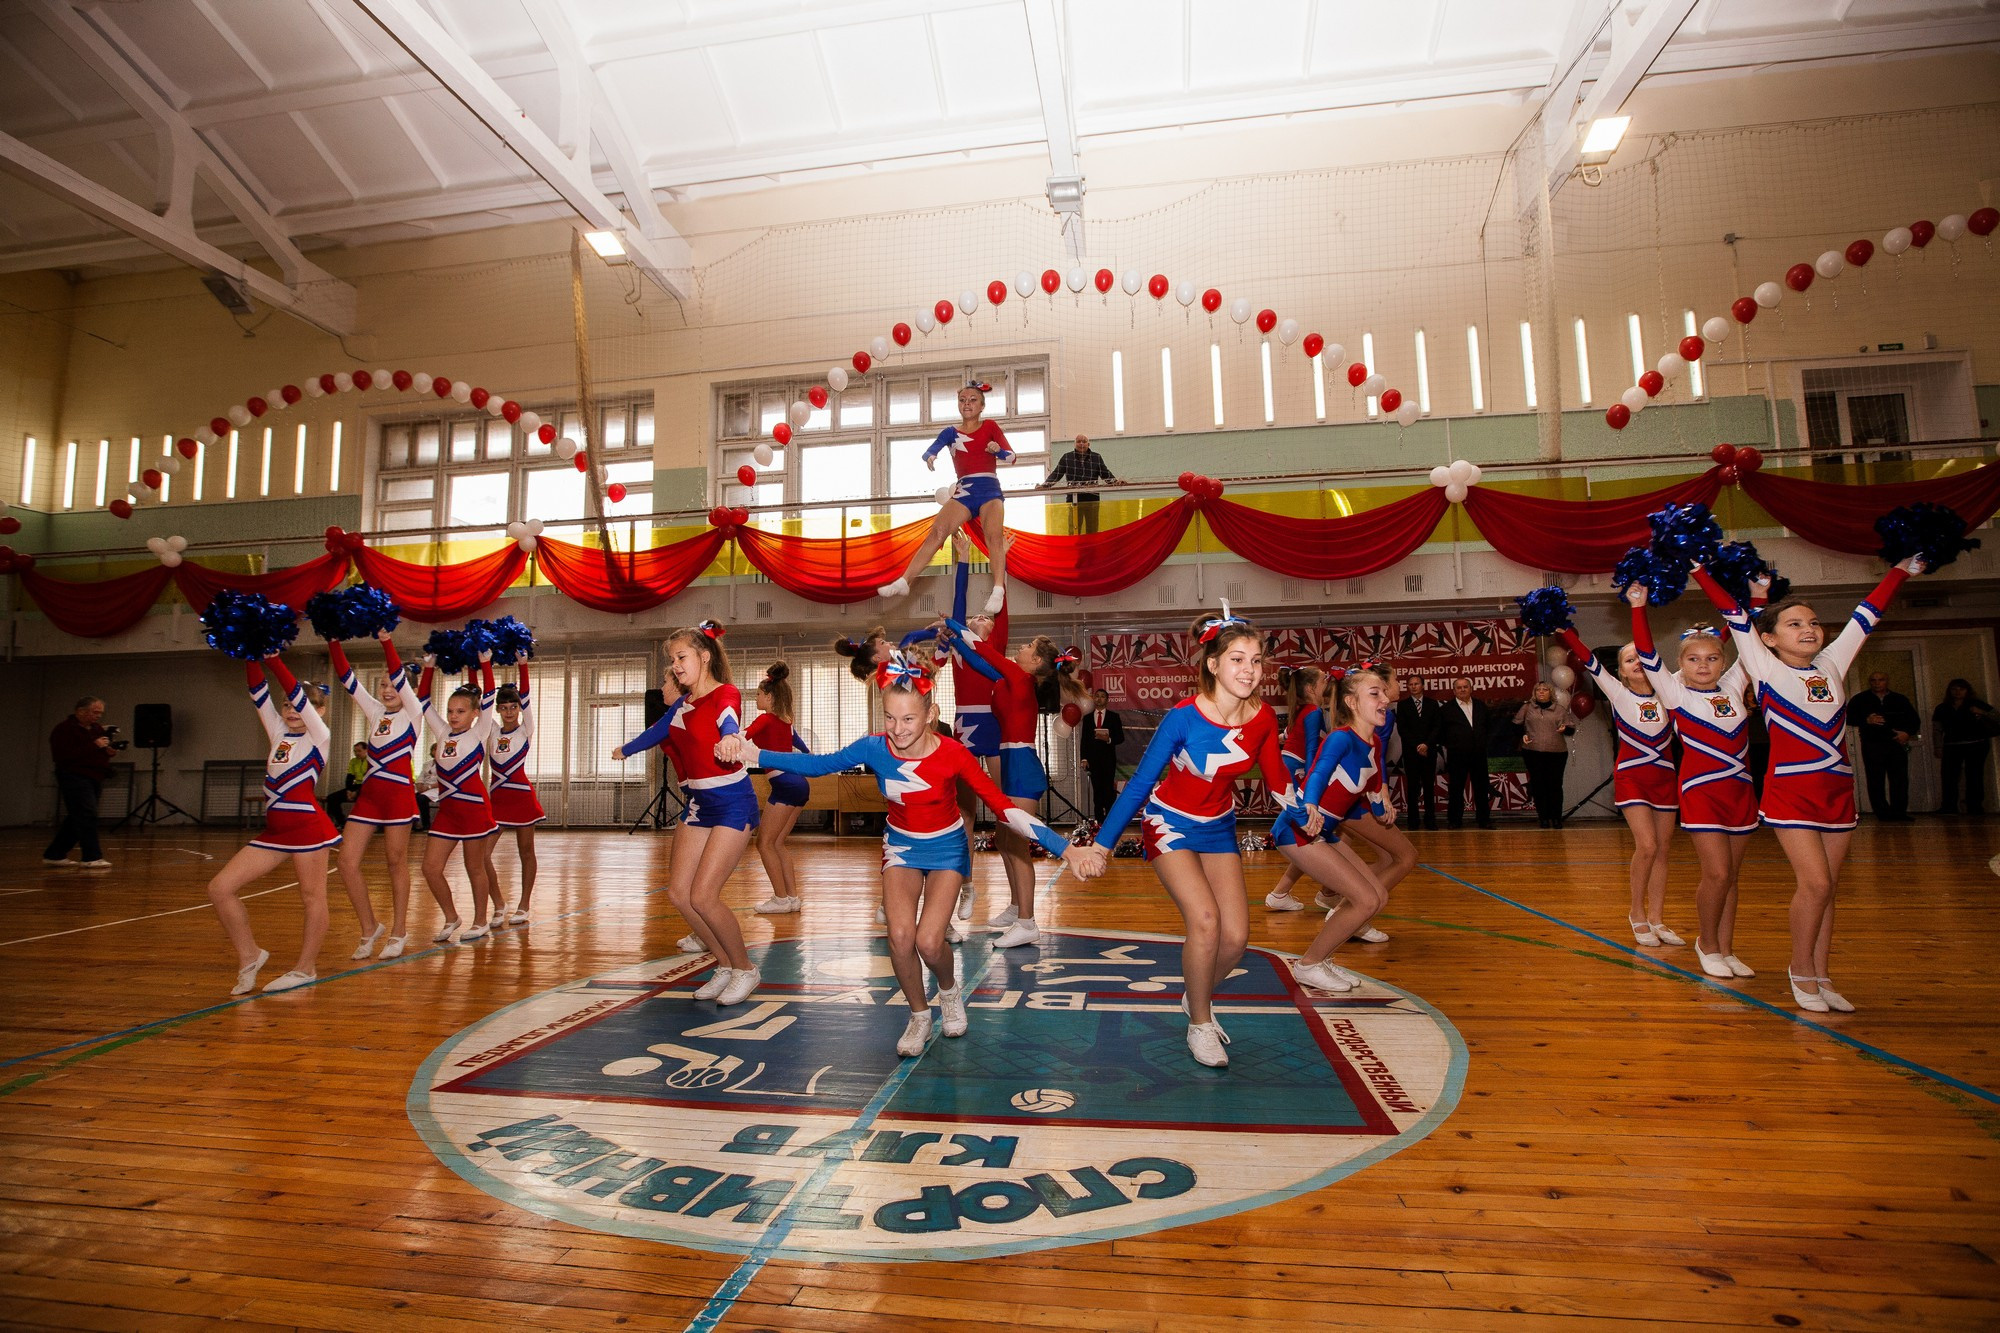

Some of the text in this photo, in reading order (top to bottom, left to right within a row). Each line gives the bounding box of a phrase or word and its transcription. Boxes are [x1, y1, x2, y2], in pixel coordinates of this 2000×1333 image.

[1136, 662, 1525, 684] СОРЕВНОВАН ЕРАЛЬНОГО ДИРЕКТОРА
[1137, 687, 1174, 700] ООО
[454, 999, 620, 1068] ПЕДАГОГИЧЕСКИЙ
[1329, 1018, 1426, 1113] ГОСУДАРСТВЕННЫЙ
[467, 1113, 1197, 1235] СПОРТИВНЫЙ
[719, 1123, 1019, 1169] КЛУБ
